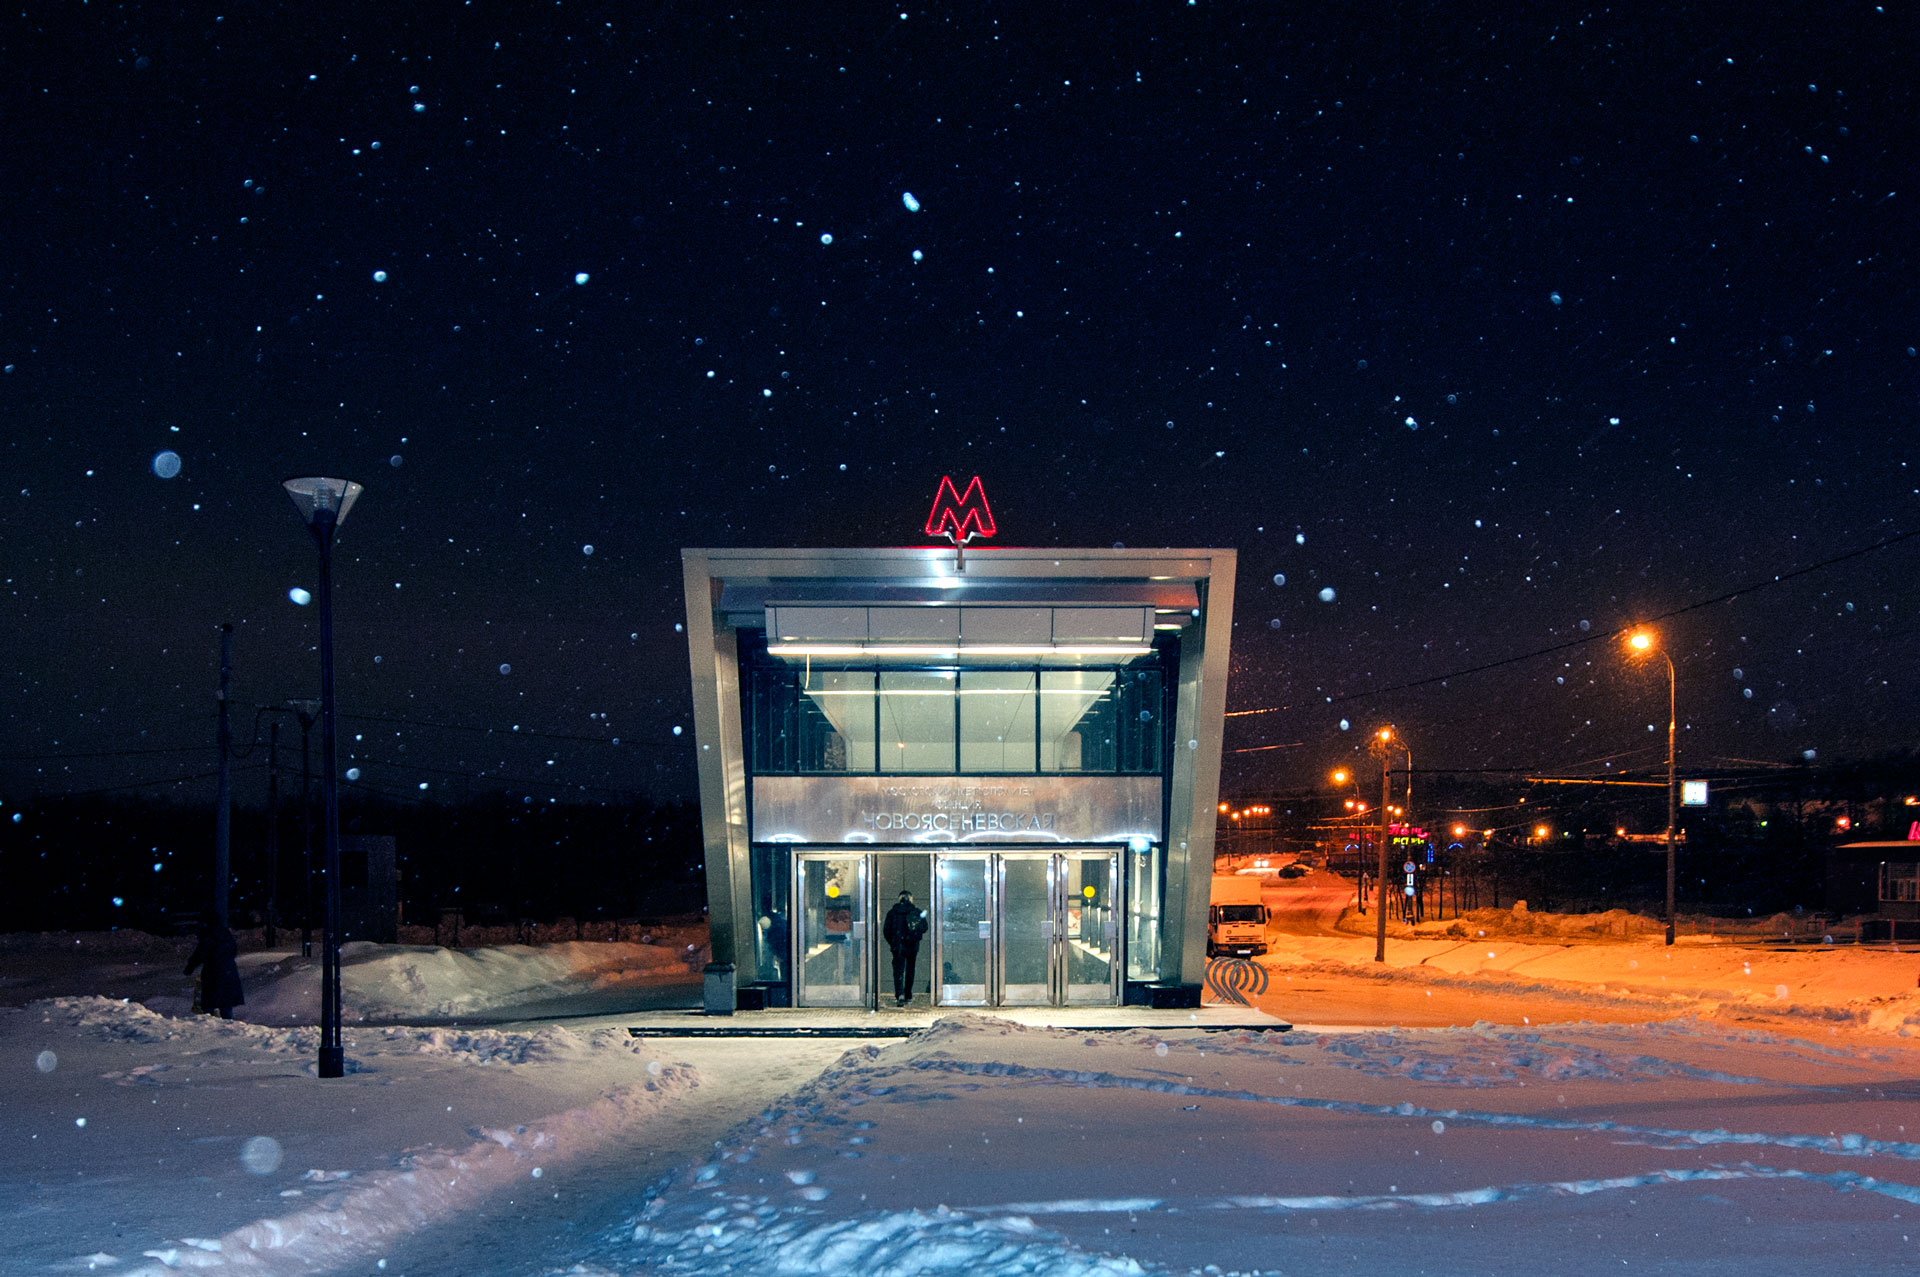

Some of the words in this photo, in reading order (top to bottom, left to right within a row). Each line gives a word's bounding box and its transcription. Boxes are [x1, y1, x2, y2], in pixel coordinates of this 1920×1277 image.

[925, 475, 997, 537] М
[935, 800, 982, 811] СТАНЦИЯ
[863, 813, 1054, 831] НОВОЯСЕНЕВСКАЯ
